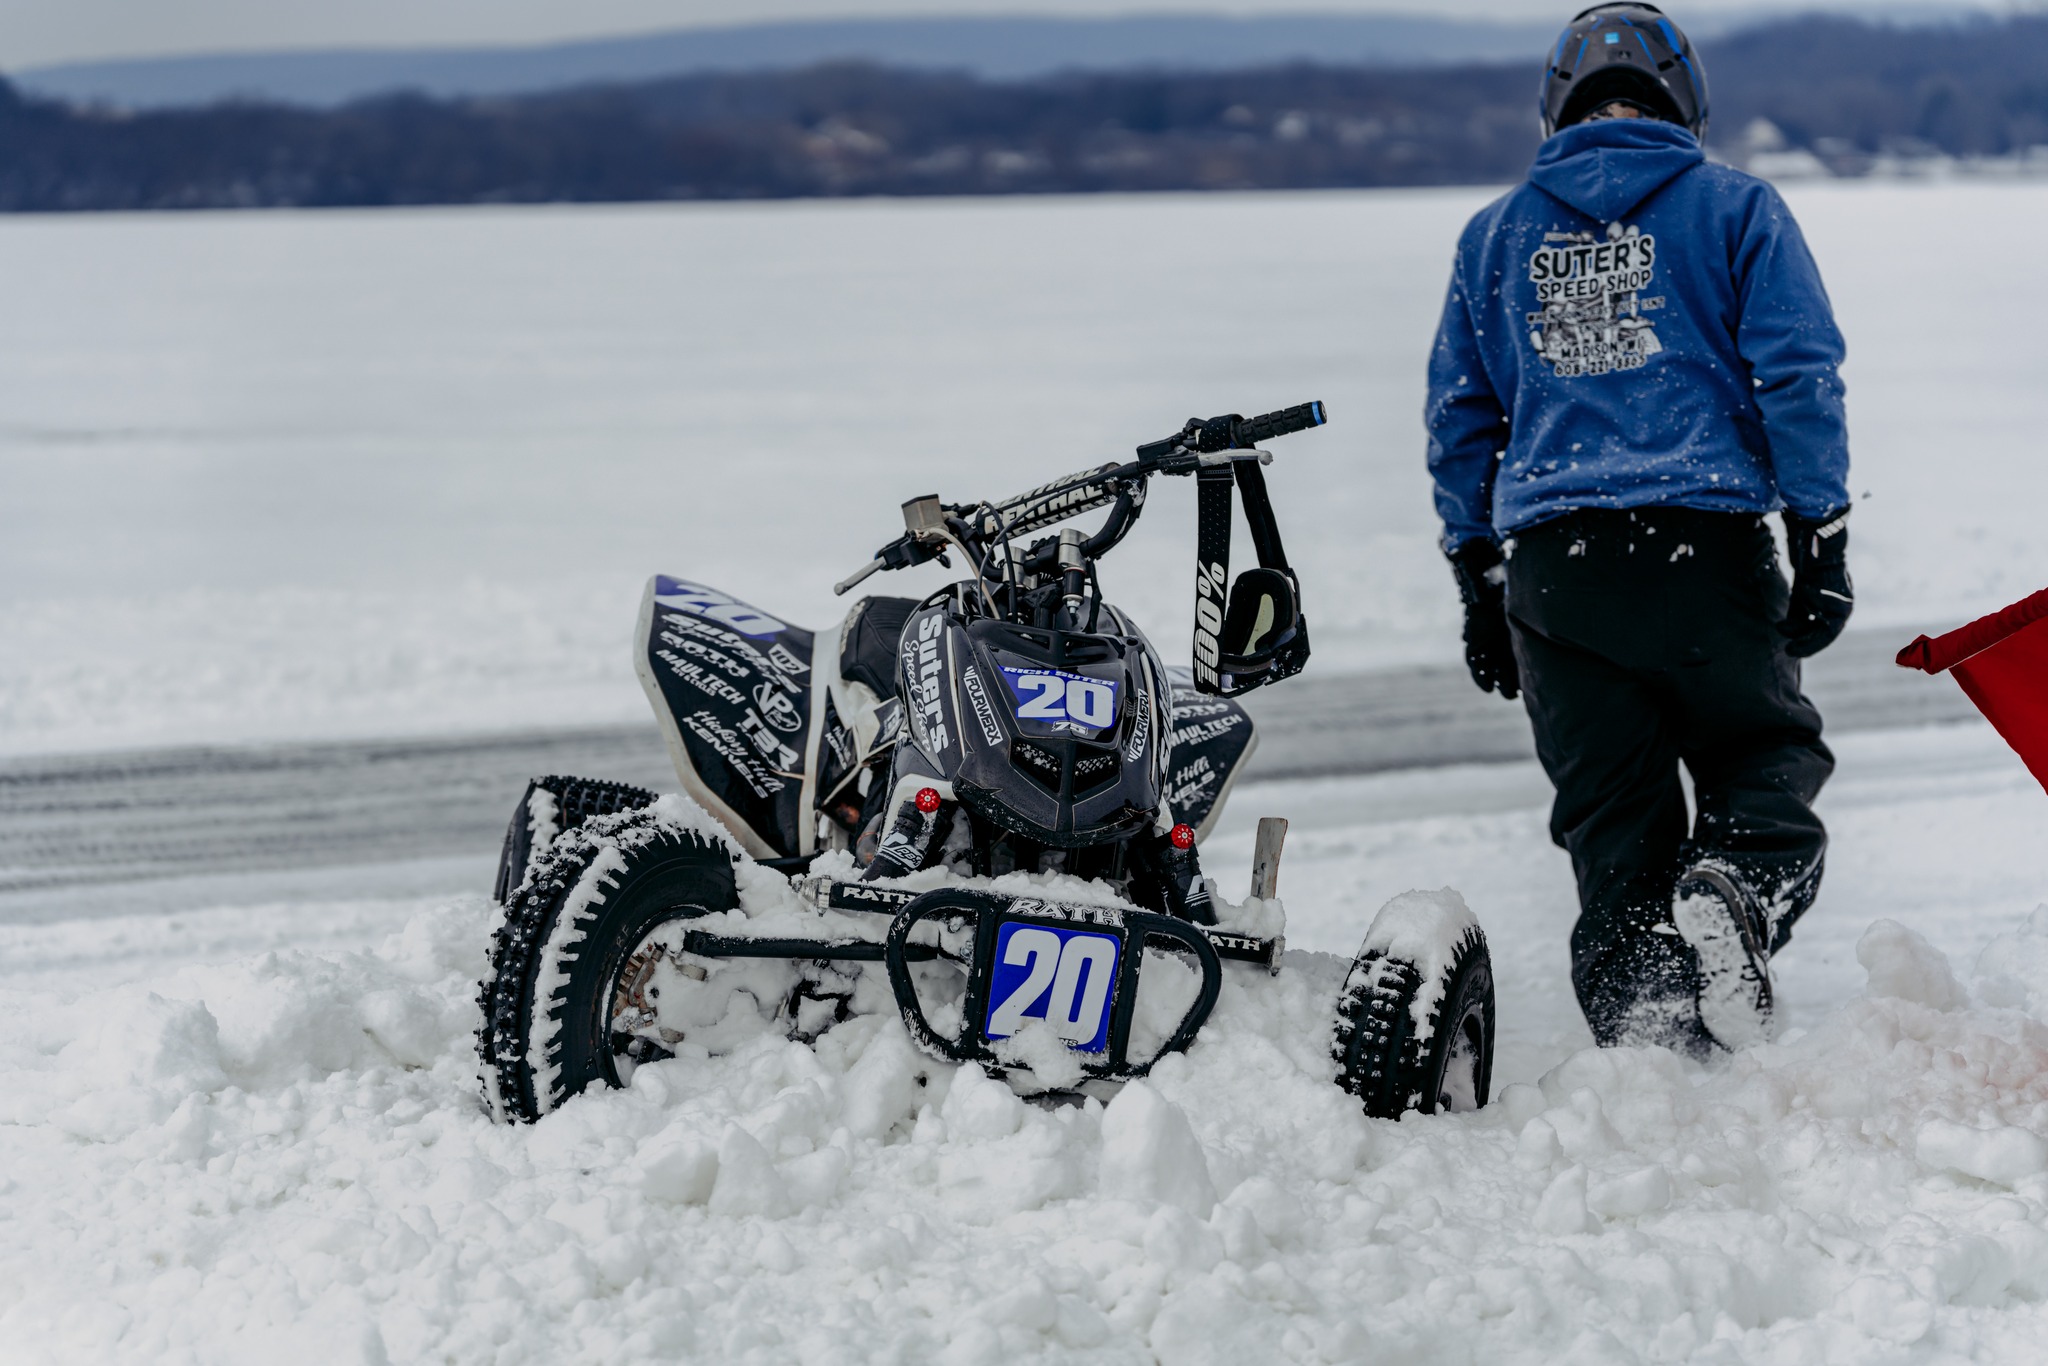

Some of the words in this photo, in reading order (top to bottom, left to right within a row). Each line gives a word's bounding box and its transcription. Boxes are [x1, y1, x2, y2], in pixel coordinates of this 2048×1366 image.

[1532, 237, 1653, 281] SUTER'S
[1538, 277, 1600, 300] SPEED
[1606, 269, 1651, 292] SHOP
[1195, 559, 1226, 688] 100%
[656, 649, 704, 680] MAUL
[703, 673, 746, 705] TECH
[902, 640, 924, 694] Speed
[919, 613, 949, 754] Suters
[1003, 666, 1051, 677] RICH
[1055, 669, 1116, 687] SUTER
[757, 681, 795, 716] VP
[966, 676, 1002, 744] FOURWERX
[1017, 674, 1114, 728] 20
[1204, 713, 1244, 733] TECH
[682, 716, 769, 799] KENNELS
[843, 886, 917, 905] RATH
[1006, 897, 1125, 929] RATH
[1205, 934, 1260, 952] ATH
[987, 927, 1117, 1046] 20
